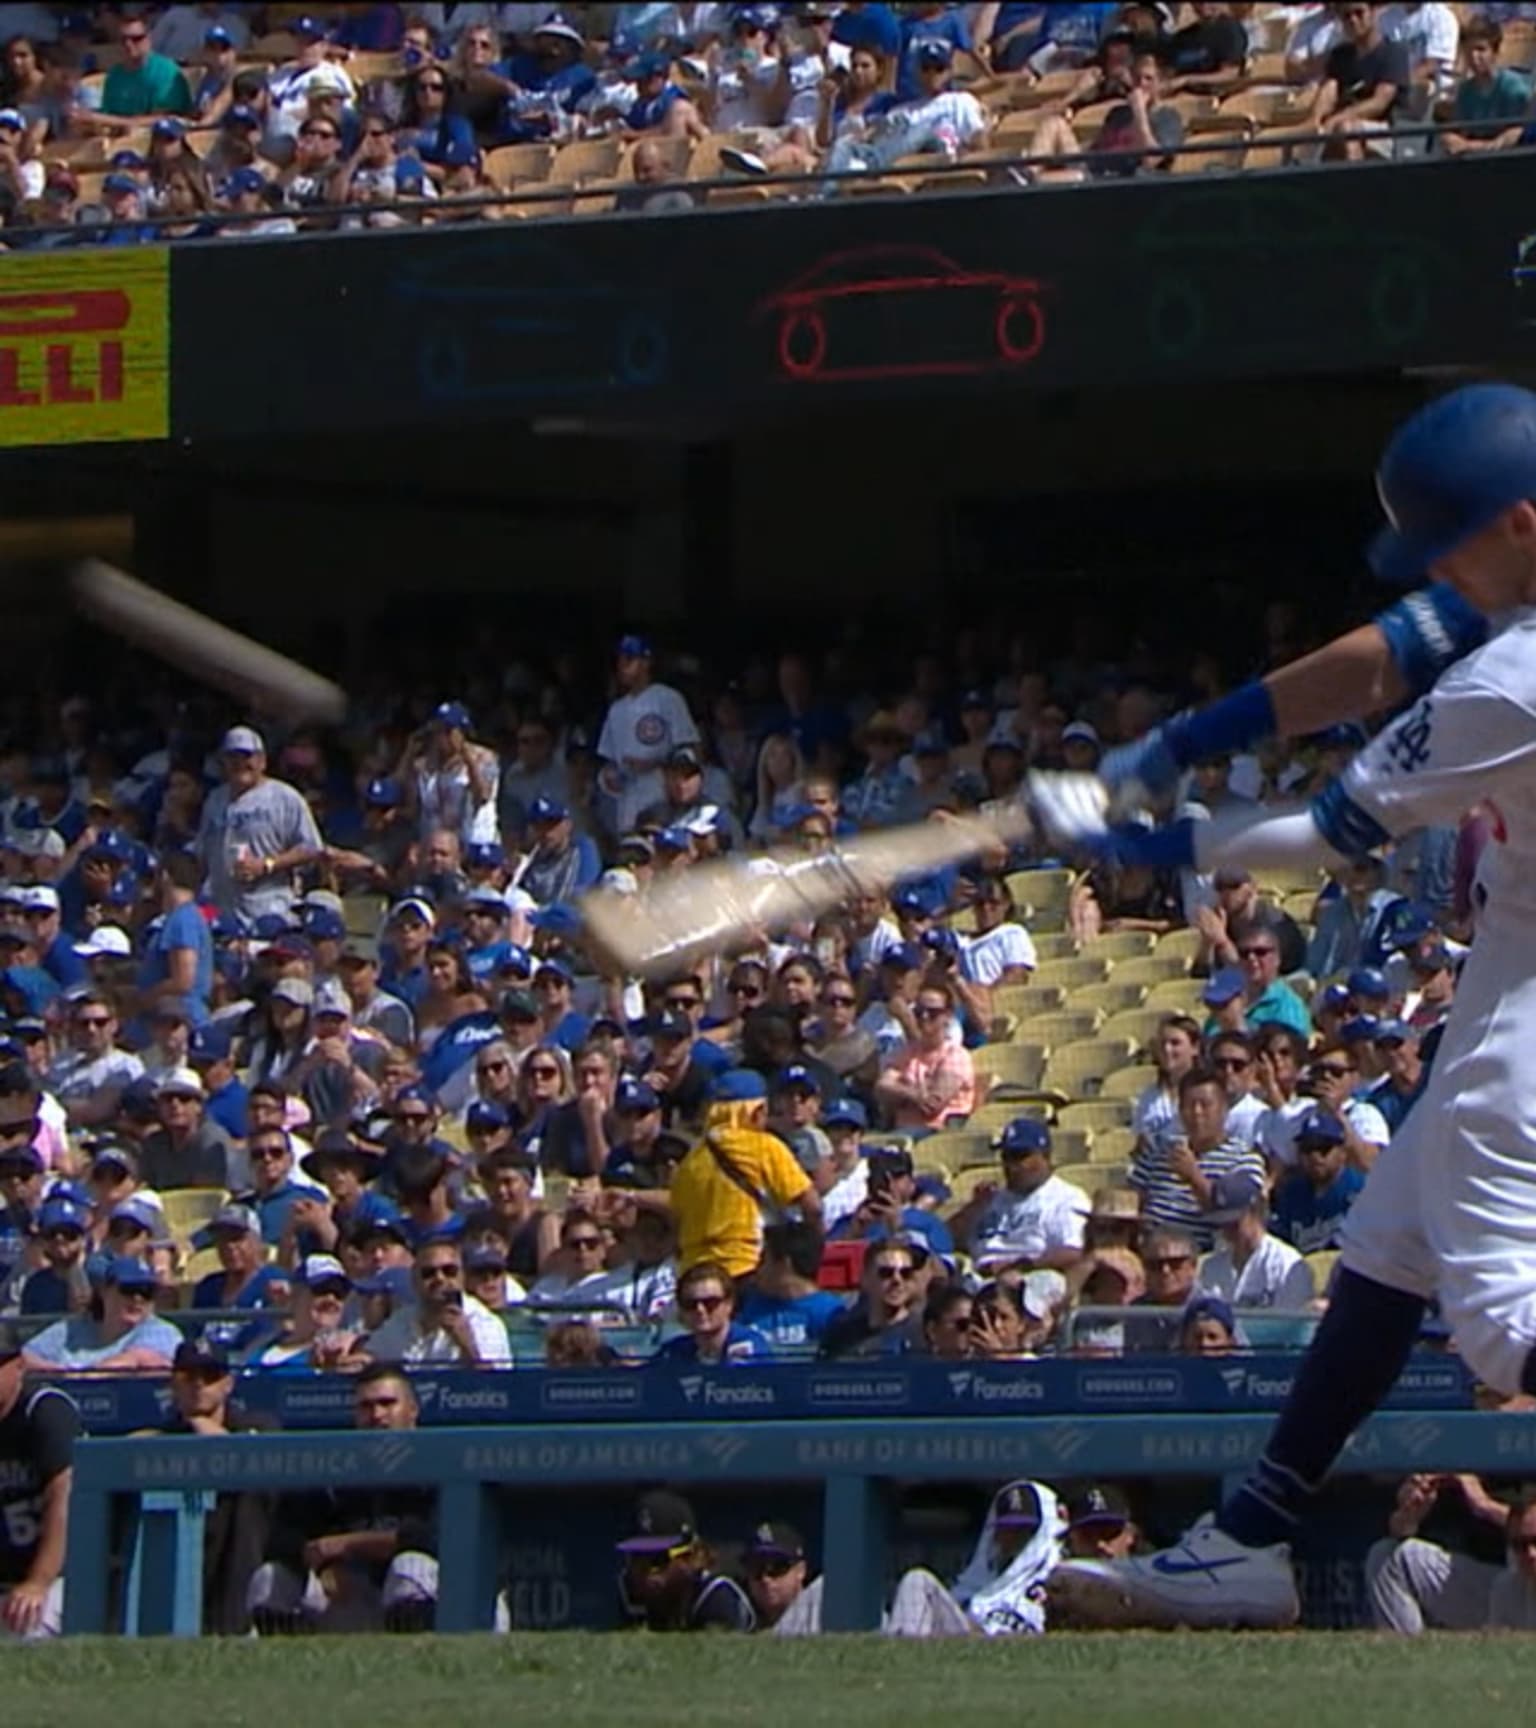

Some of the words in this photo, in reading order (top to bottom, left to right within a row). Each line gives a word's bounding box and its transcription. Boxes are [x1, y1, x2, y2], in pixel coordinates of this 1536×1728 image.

[704, 1381, 774, 1403] Fanatics
[973, 1375, 1044, 1399] Fanatics
[1247, 1370, 1291, 1396] Fana
[439, 1387, 509, 1409] Fanatics
[462, 1446, 534, 1472] BANK
[538, 1445, 568, 1469] OF
[568, 1440, 691, 1469] AMERICA
[797, 1439, 866, 1463] BANK
[912, 1436, 1031, 1461] AMERICA
[1141, 1435, 1212, 1459] BANK
[134, 1456, 200, 1479] BANK
[208, 1455, 237, 1477] OF
[241, 1448, 359, 1476] AMERICA
[512, 1581, 571, 1619] ELD
